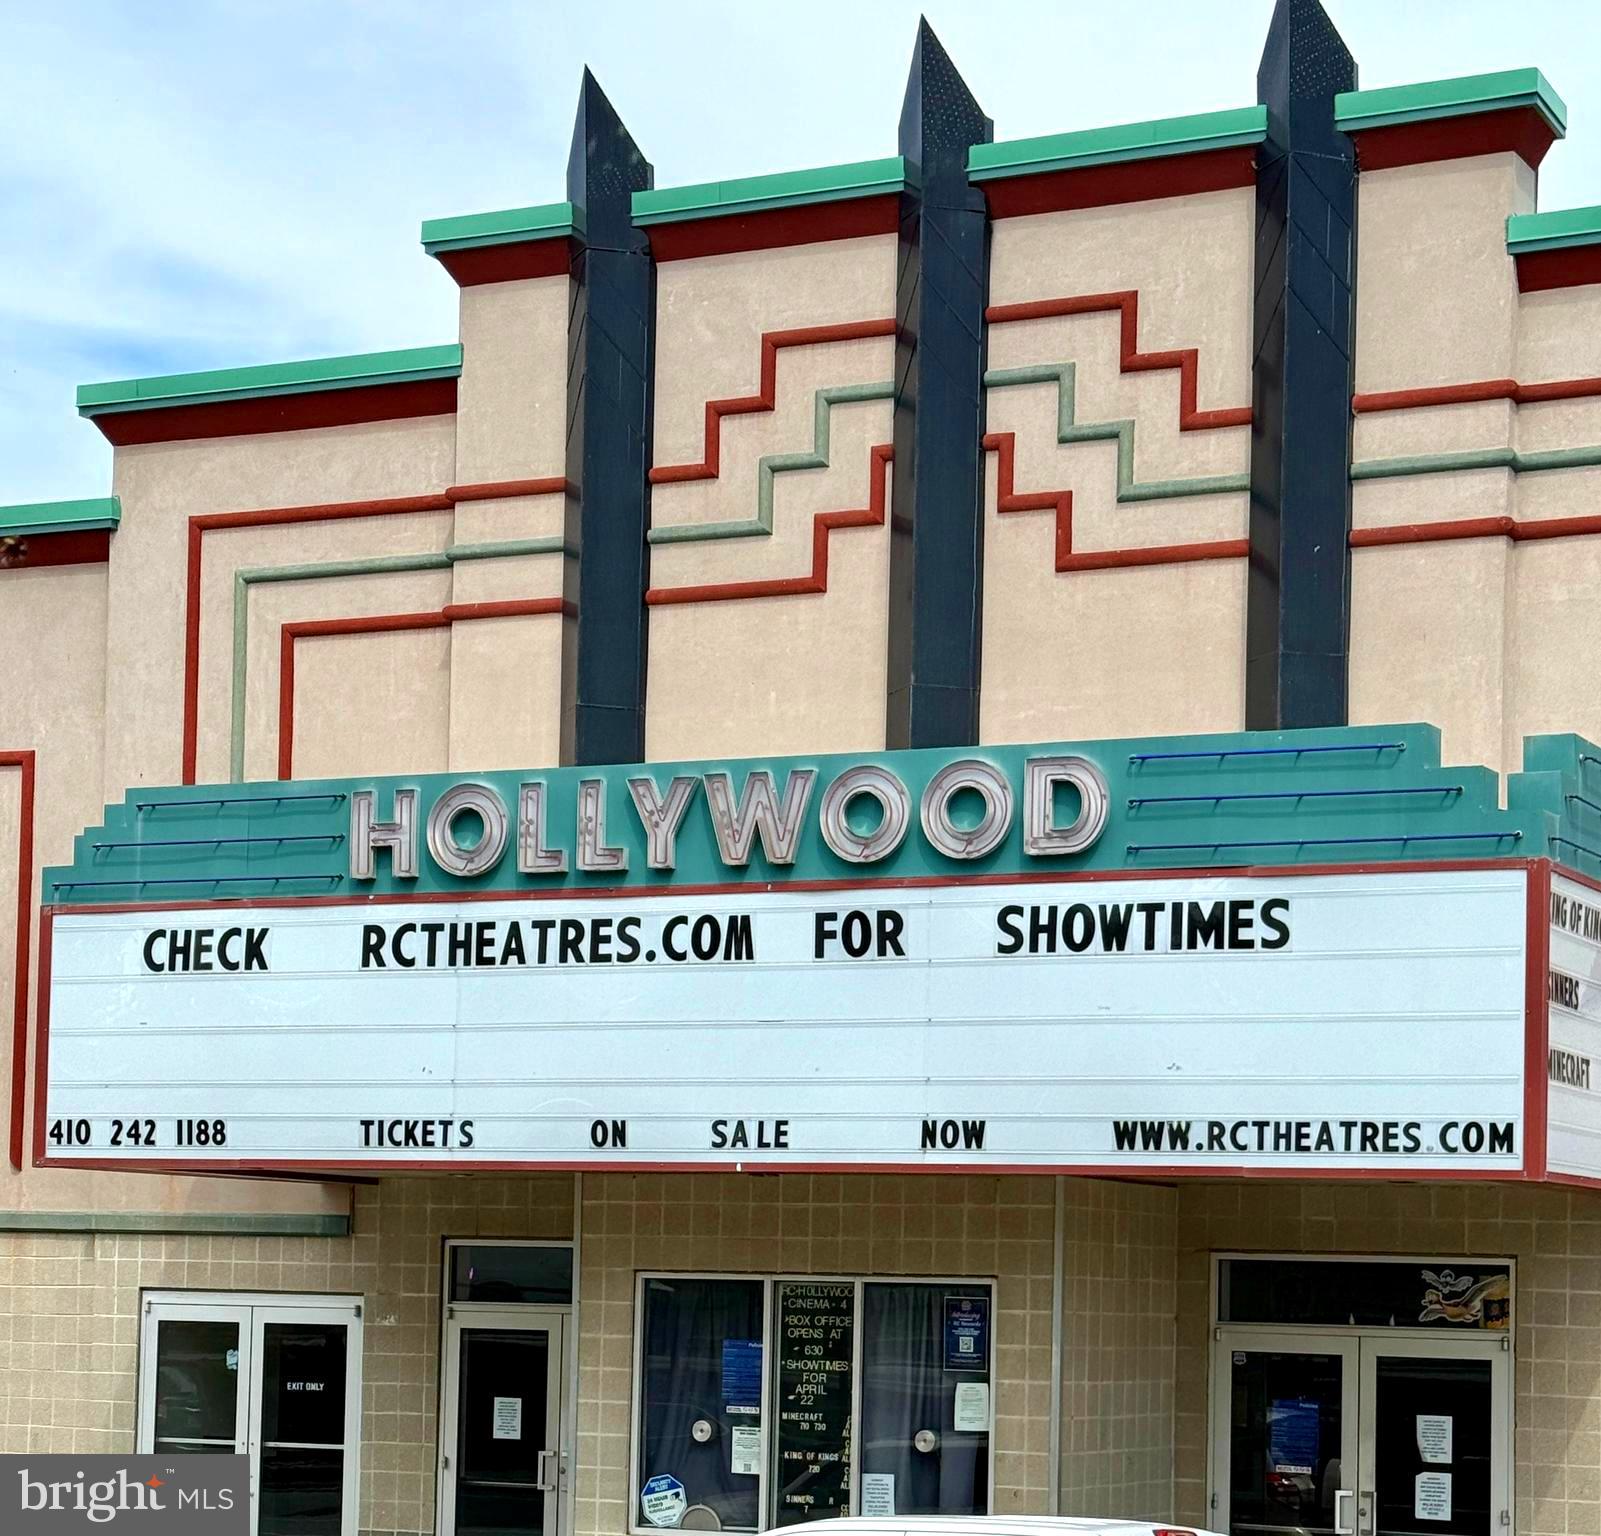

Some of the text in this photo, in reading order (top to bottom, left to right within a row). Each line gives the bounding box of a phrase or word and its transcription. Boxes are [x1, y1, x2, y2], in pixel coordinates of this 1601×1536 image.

[351, 756, 1110, 879] HOLLYWOOD
[1550, 892, 1601, 942] ING OF KIN
[144, 899, 1290, 972] CHECK RCTHEATRES.COM FOR SHOWTIMES
[50, 1119, 1514, 1153] 410 242 1188 TICKETS ON SALE NOW WWW.RCTHEATRES.COM
[788, 1298, 830, 1309] CINEMA
[789, 1315, 853, 1327] BOX OFFICE
[787, 1328, 844, 1340] OPENS AT
[804, 1345, 824, 1356] 630
[786, 1360, 849, 1371] SHOWTIMES
[803, 1373, 827, 1384] FOR
[287, 1382, 325, 1392] EXIT ONLY
[795, 1384, 828, 1395] APRIL
[800, 1395, 814, 1406] 22
[782, 1412, 823, 1421] MINECRAFT
[784, 1451, 840, 1461] KING OF KINGS
[785, 1495, 814, 1505] SINNERS
